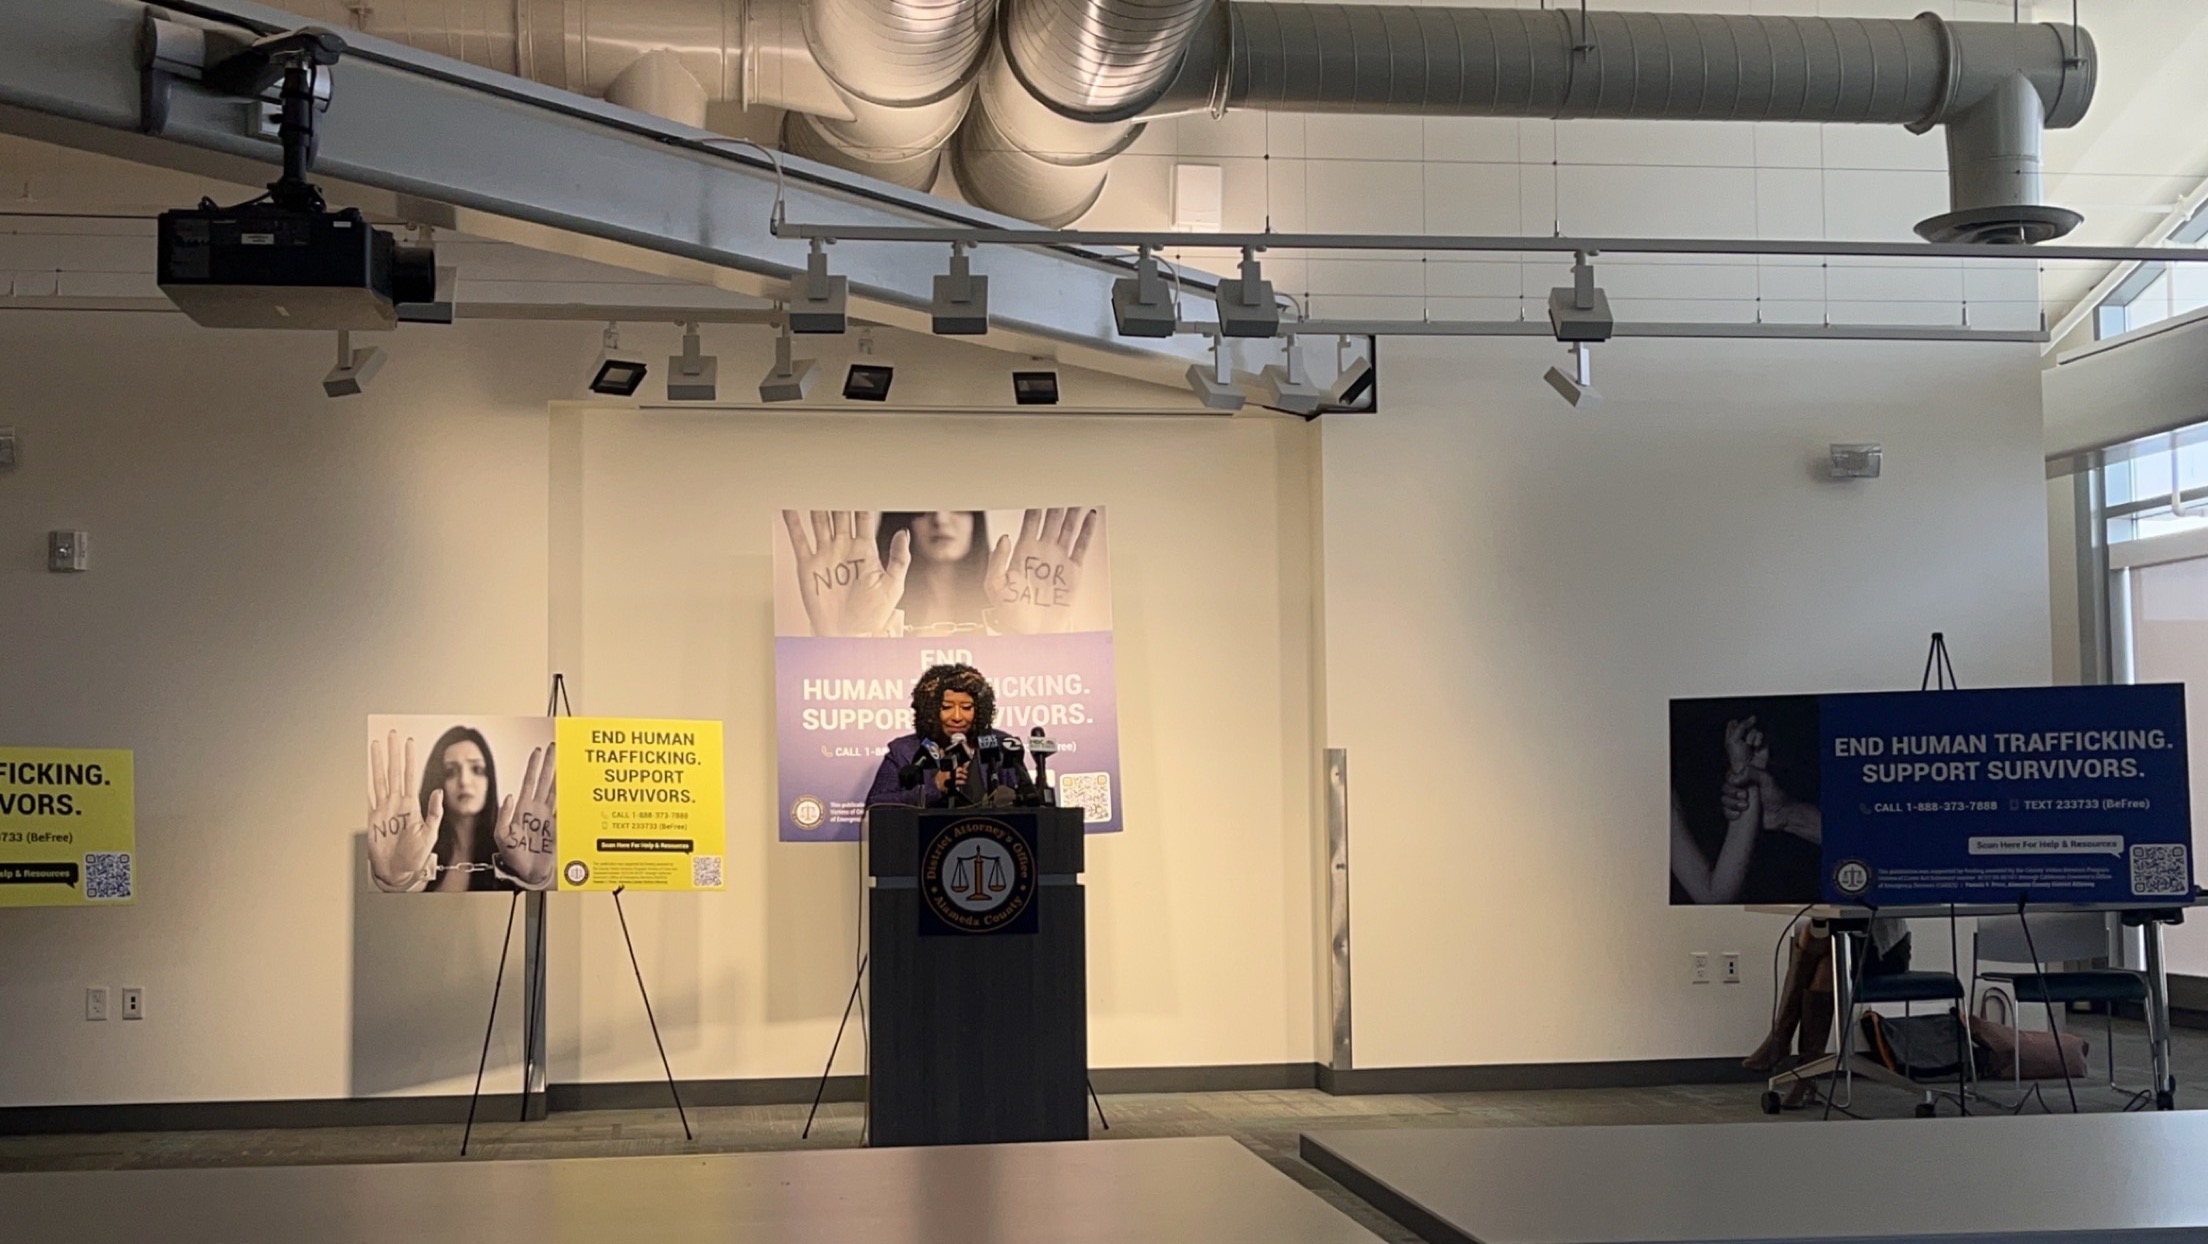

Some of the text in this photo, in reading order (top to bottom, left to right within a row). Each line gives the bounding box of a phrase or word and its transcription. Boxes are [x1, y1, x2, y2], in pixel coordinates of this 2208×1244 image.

[812, 559, 865, 596] NOT
[1023, 556, 1067, 586] FOR
[1003, 582, 1070, 608] SALE
[803, 679, 903, 701] HUMAN
[802, 708, 915, 731] SUPPOR
[592, 730, 695, 746] END HUMAN
[1834, 729, 2174, 757] END HUMAN TRAFFICKING.
[585, 749, 701, 765] TRAFFICKING.
[835, 747, 861, 757] CALL
[604, 769, 684, 783] SUPPORT
[1862, 757, 2145, 783] SUPPORT SURVIVORS.
[593, 788, 696, 803] SURVIVORS.
[1874, 798, 2151, 812] CALL 1-888-373-7888 TEXT 233733 (BeFree)
[522, 812, 551, 837] FOR
[612, 811, 629, 819] CALL
[373, 812, 411, 842] NOT
[612, 822, 629, 830] TEXT
[26, 832, 73, 844] (BeFree)
[507, 836, 553, 854] SALE
[2022, 840, 2037, 848] For
[2038, 840, 2059, 849] Help
[2070, 840, 2117, 848] Resources
[926, 834, 953, 881] District
[934, 894, 1023, 926] Alameda County
